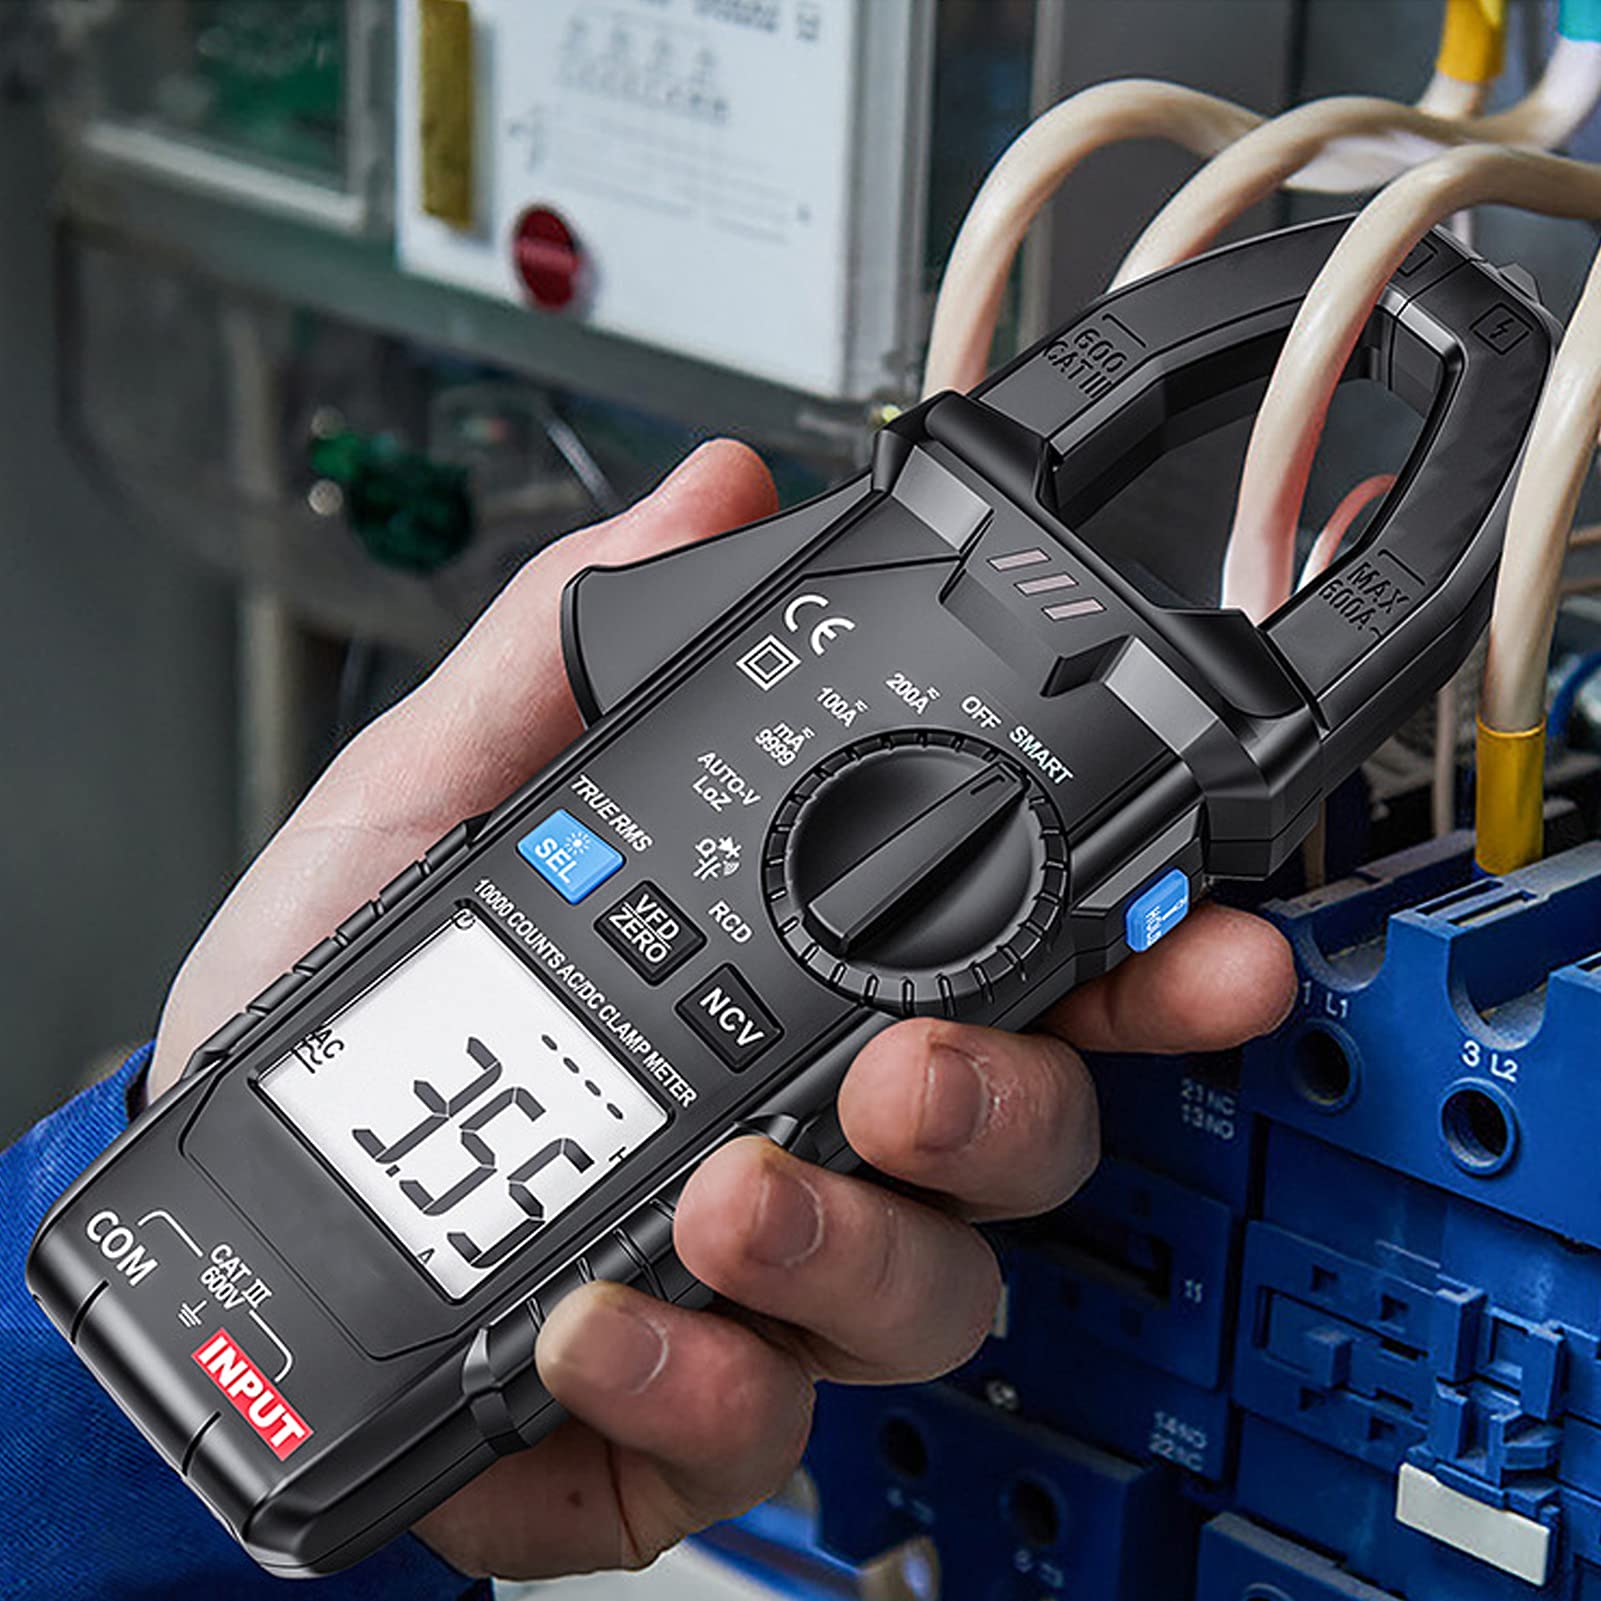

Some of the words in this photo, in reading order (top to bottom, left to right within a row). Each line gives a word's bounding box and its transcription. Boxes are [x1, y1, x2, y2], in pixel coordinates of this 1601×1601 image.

[1073, 328, 1128, 373] 600
[1346, 561, 1410, 614] MAX
[785, 594, 856, 656] CE
[961, 696, 1002, 729] OFF
[754, 728, 797, 767] 9999
[1009, 725, 1074, 784] SMART
[692, 775, 733, 812] LoZ
[697, 752, 761, 805] AUTO-V
[570, 774, 621, 820] TRUE
[608, 813, 653, 852] RMS
[534, 838, 577, 884] SEL
[608, 906, 668, 964] ZERO
[635, 893, 680, 941] VFD
[707, 900, 753, 942] RCD
[474, 878, 513, 918] 10000
[507, 910, 566, 969] COUNTS
[556, 963, 606, 1010] AC/DC
[598, 1004, 652, 1055] CLAMP
[642, 1050, 698, 1108] METER
[699, 987, 765, 1047] NCV
[1325, 991, 1348, 1019] L1
[1461, 1039, 1480, 1068] 3
[1490, 1052, 1518, 1083] L2
[86, 1210, 159, 1288] COM
[199, 1265, 247, 1311] 600V
[209, 1243, 253, 1284] CAT
[241, 1277, 273, 1310] III
[198, 1334, 306, 1449] INPUT
